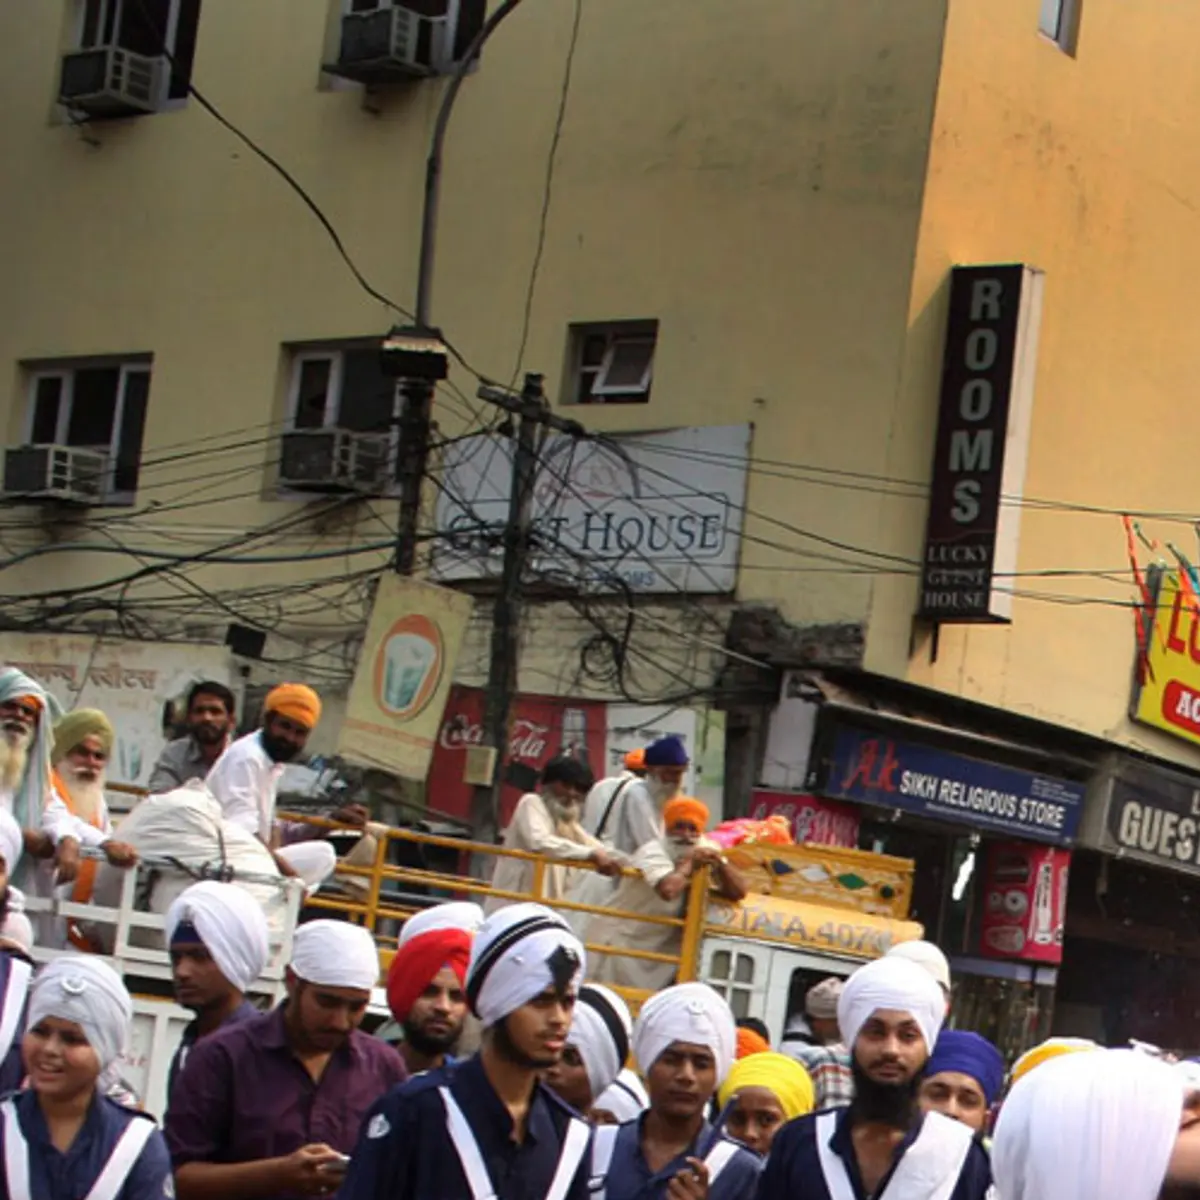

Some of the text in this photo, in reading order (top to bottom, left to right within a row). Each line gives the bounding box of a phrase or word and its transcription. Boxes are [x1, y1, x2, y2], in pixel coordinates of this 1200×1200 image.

[947, 277, 1003, 523] ROOMS
[581, 511, 721, 552] HOUSE
[927, 545, 988, 563] LUCKY
[924, 591, 985, 609] HOUSE
[899, 770, 941, 801] SIKH
[940, 778, 1018, 819] RELIGIOUS
[1017, 797, 1067, 830] STORE
